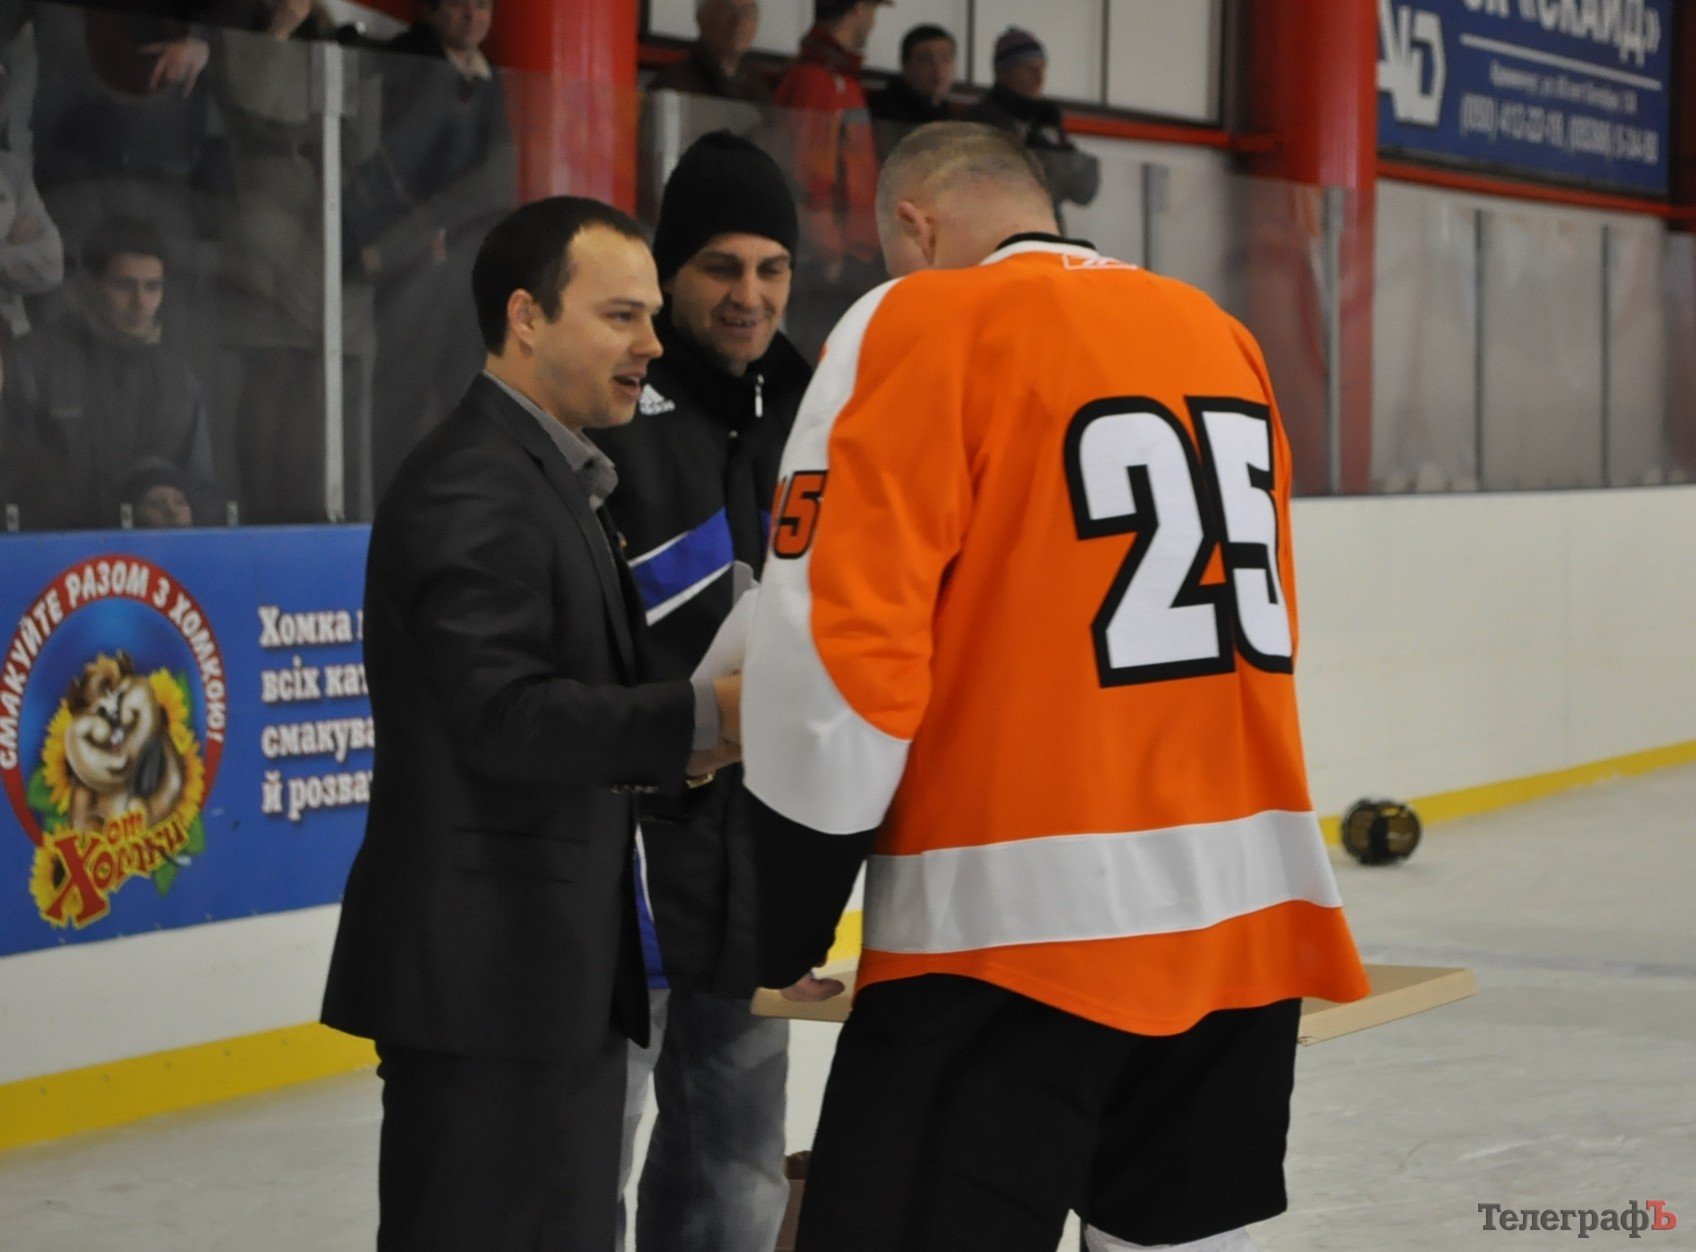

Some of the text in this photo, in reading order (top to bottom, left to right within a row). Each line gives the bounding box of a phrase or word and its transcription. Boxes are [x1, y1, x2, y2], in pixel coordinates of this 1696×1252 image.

[769, 470, 828, 560] 5
[1063, 395, 1294, 688] 25
[258, 606, 353, 647] Хомка
[0, 588, 63, 769] СМАКУЙТЕ
[65, 560, 150, 608] РАЗОМ
[262, 655, 320, 703] всіх
[262, 769, 373, 820] й розва
